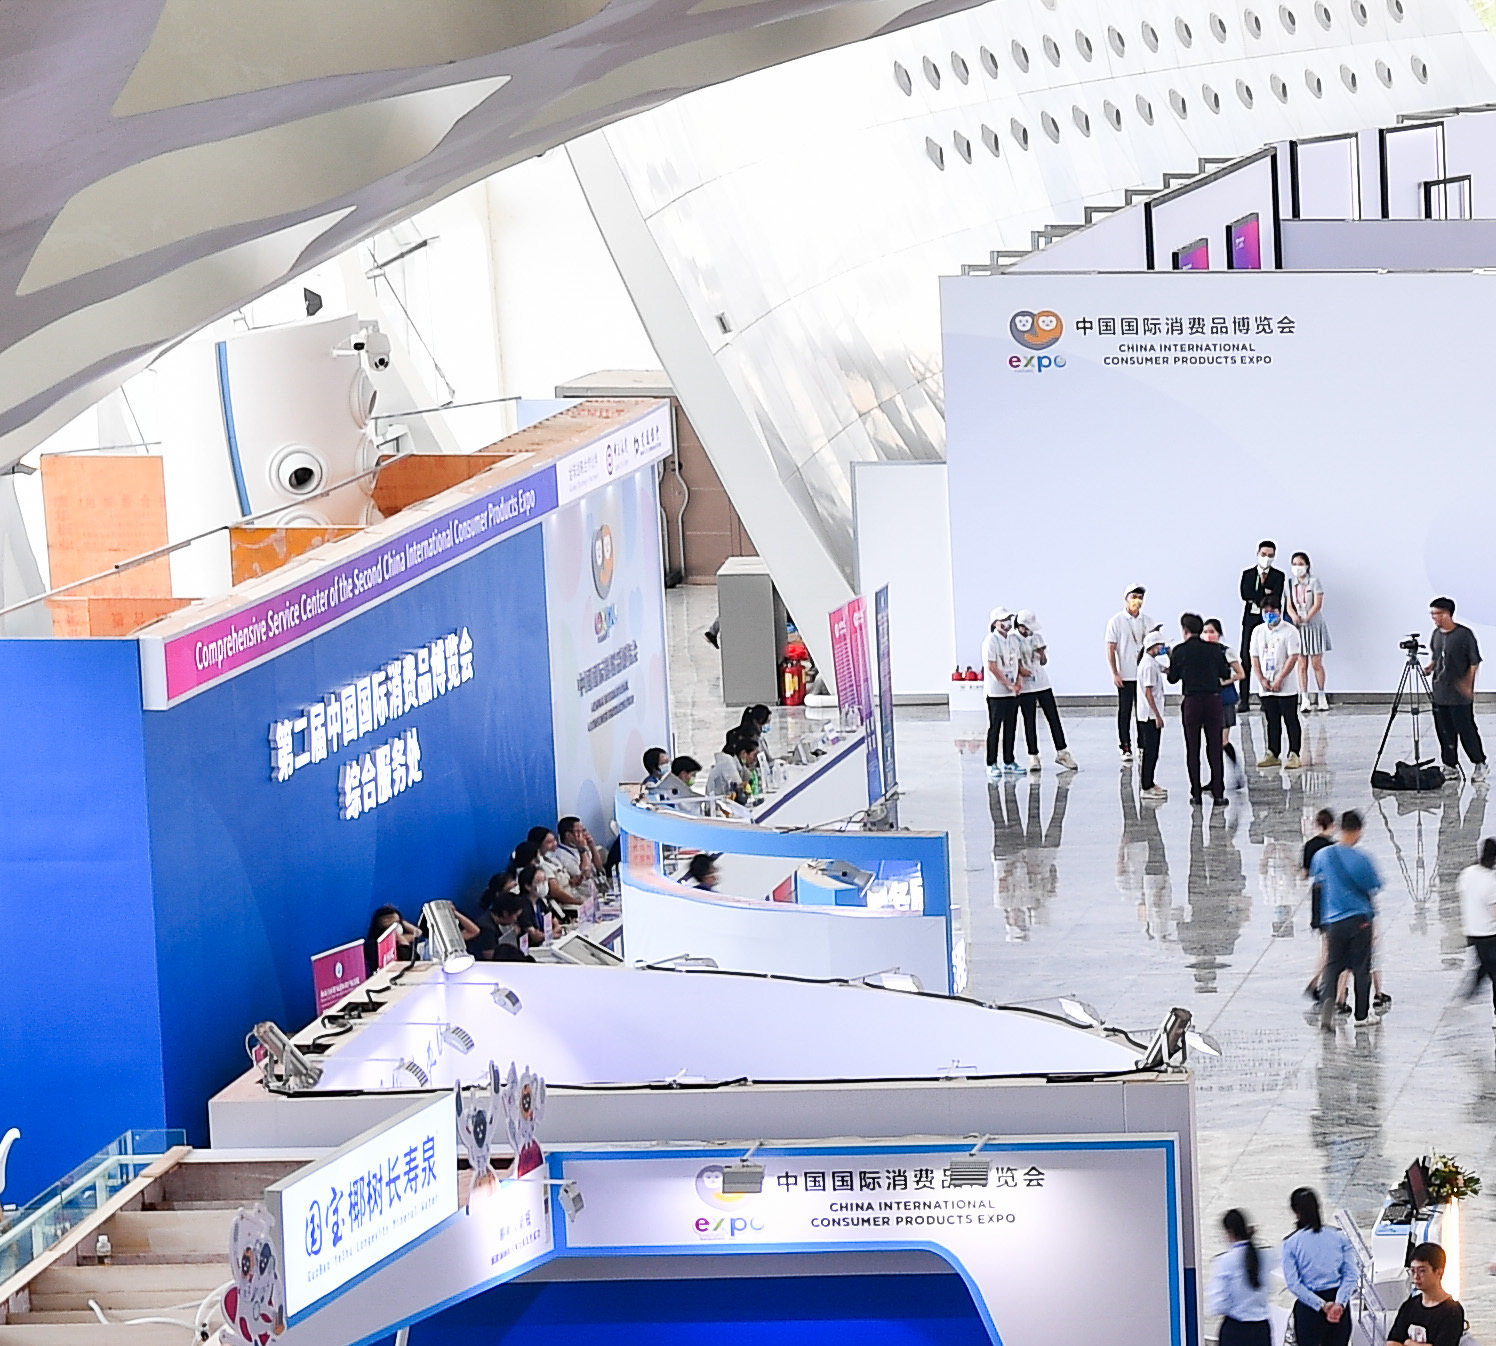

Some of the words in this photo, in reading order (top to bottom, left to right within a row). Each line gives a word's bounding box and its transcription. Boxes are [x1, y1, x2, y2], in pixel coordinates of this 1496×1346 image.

[1075, 315, 1296, 336] 中国国际消费品博览会
[1118, 343, 1156, 353] CHINA
[1159, 343, 1256, 352] INTERNATIONAL
[1008, 355, 1067, 373] expo
[1103, 356, 1170, 366] CONSUMER
[1173, 356, 1238, 365] PRODUCTS
[1240, 355, 1273, 365] EXPO
[195, 617, 267, 670] Comprehensive
[268, 602, 300, 637] Service
[300, 586, 330, 620] Center
[330, 580, 341, 609] of
[339, 573, 353, 602] the
[353, 559, 383, 594] Second
[383, 546, 406, 583] China
[406, 521, 454, 569] International
[453, 511, 488, 547] Consumer
[488, 496, 519, 533] Products
[518, 488, 536, 519] Expo
[272, 626, 475, 783] 第二届中国国际消费品博览会
[340, 727, 424, 820] 综合服务处
[776, 1165, 1046, 1193] 中国国际消费览会
[304, 1134, 438, 1257] 国宝椰树长寿泉
[829, 1201, 875, 1213] CHINA
[878, 1199, 996, 1212] INTERNATIONAL
[810, 1216, 891, 1228] CONSUMER
[895, 1214, 973, 1227] PRODUCTS
[977, 1213, 1017, 1225] EXPO
